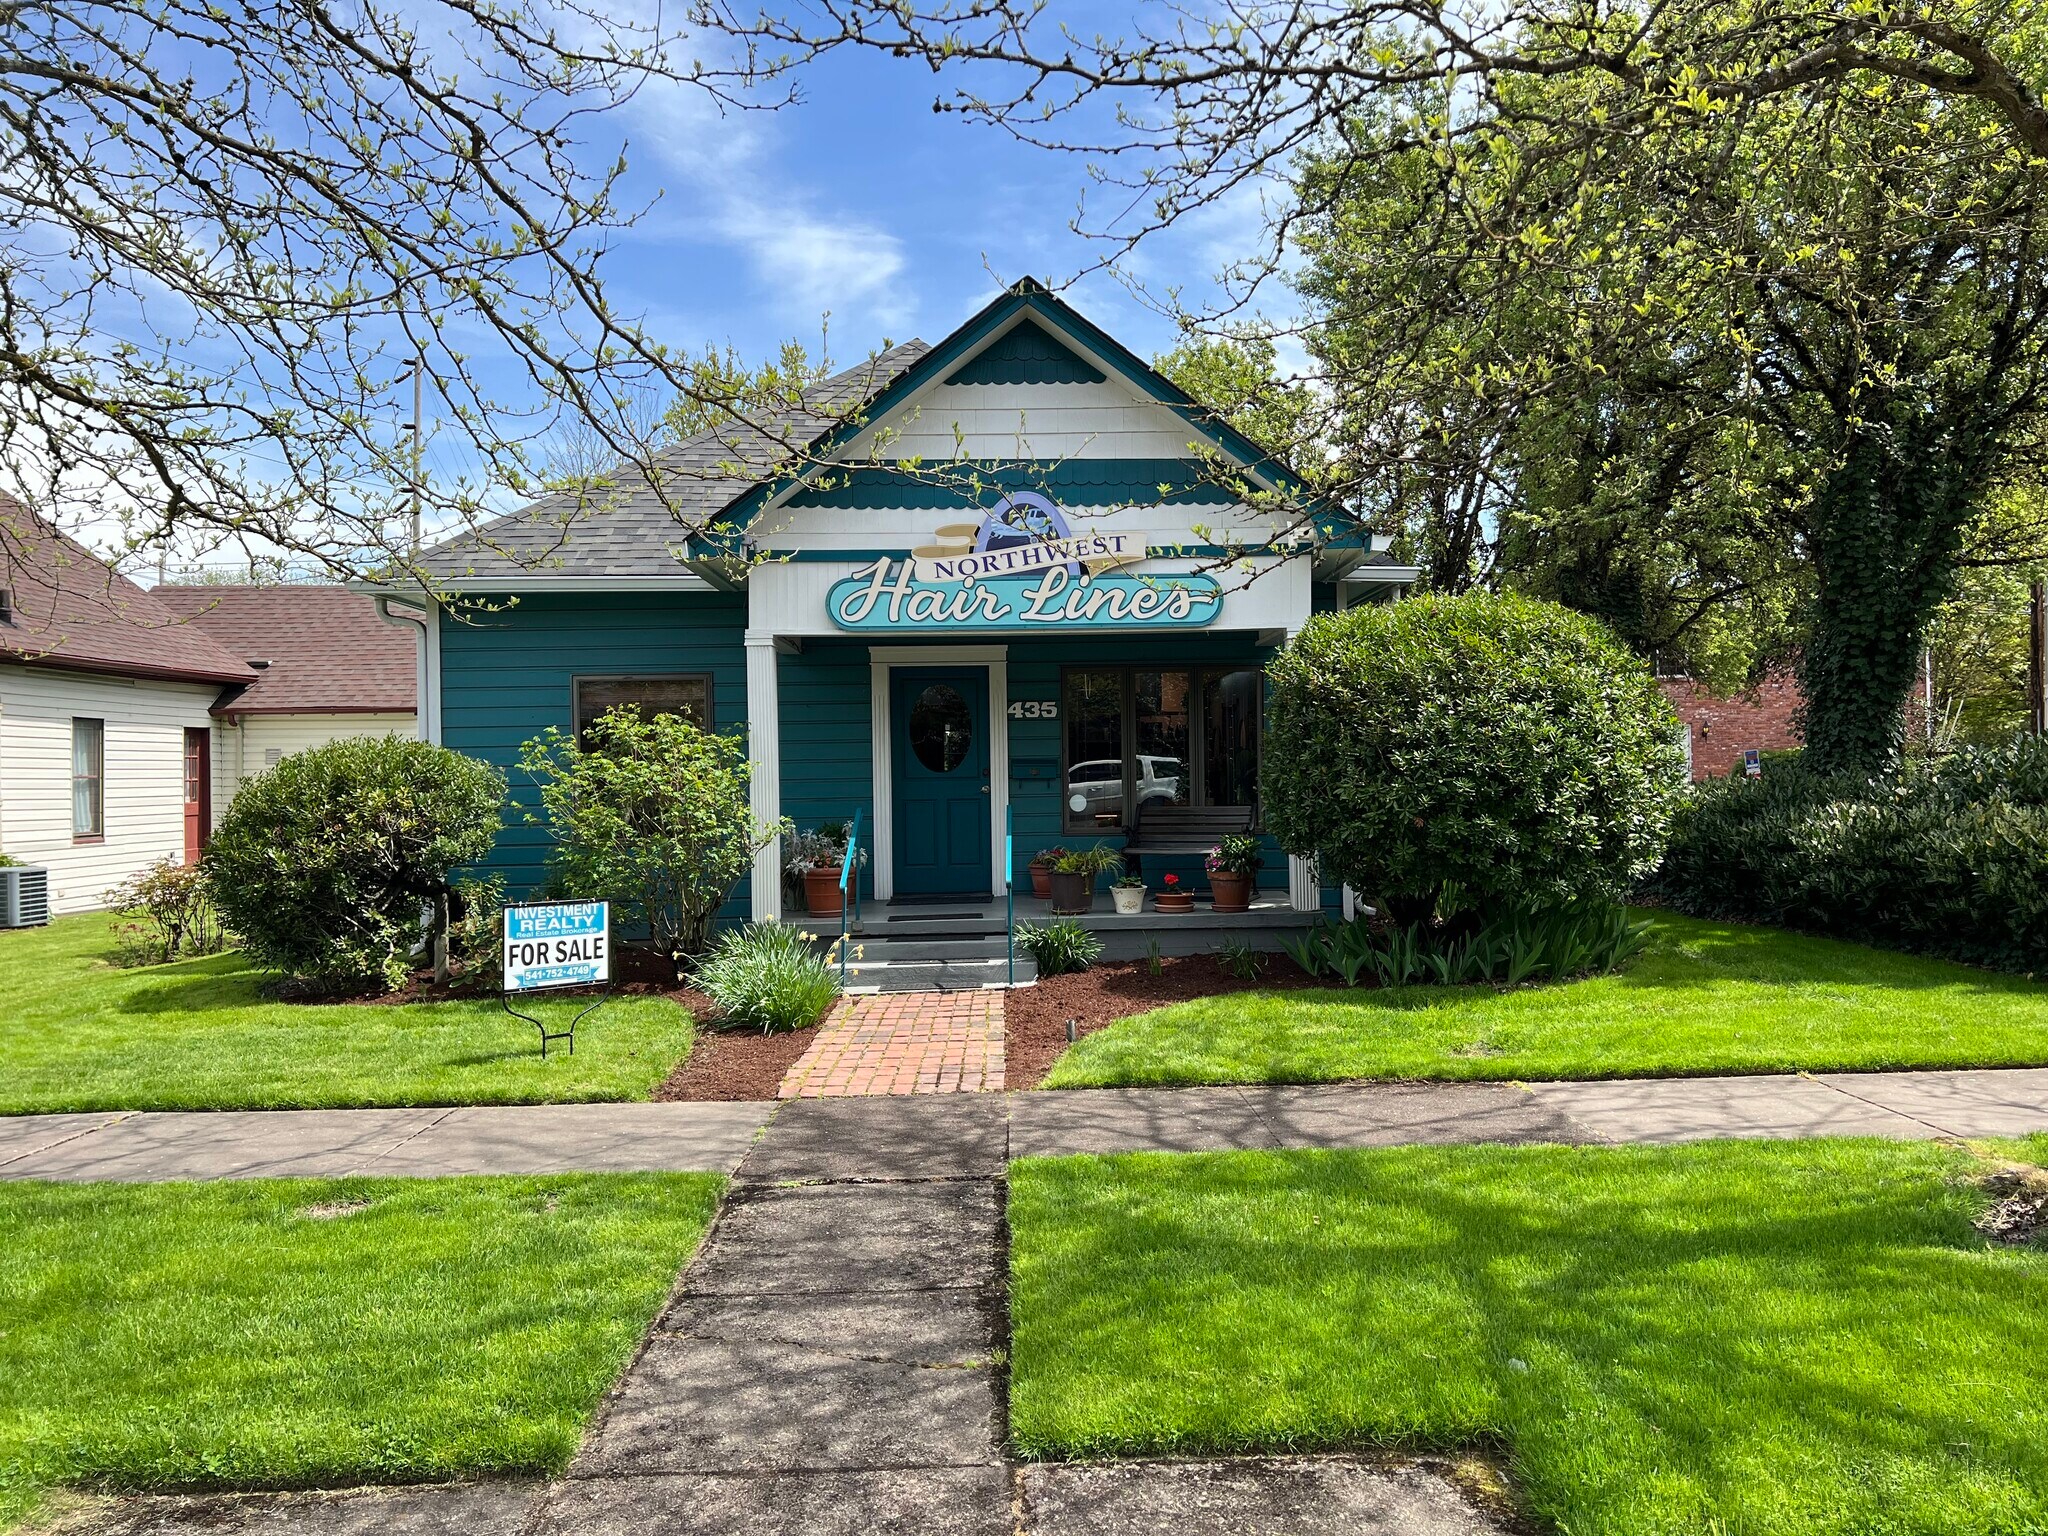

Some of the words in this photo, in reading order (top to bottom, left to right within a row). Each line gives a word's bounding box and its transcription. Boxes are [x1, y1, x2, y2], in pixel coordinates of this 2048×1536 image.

[934, 535, 1127, 579] NORTHWEST
[839, 556, 1012, 623] Hair
[1019, 566, 1215, 622] Lines
[1007, 701, 1058, 718] 435
[515, 903, 599, 920] INVESTMENT
[520, 915, 594, 932] REALTY
[561, 927, 598, 935] Brokerage
[509, 942, 549, 967] FOR
[555, 937, 604, 963] SALE
